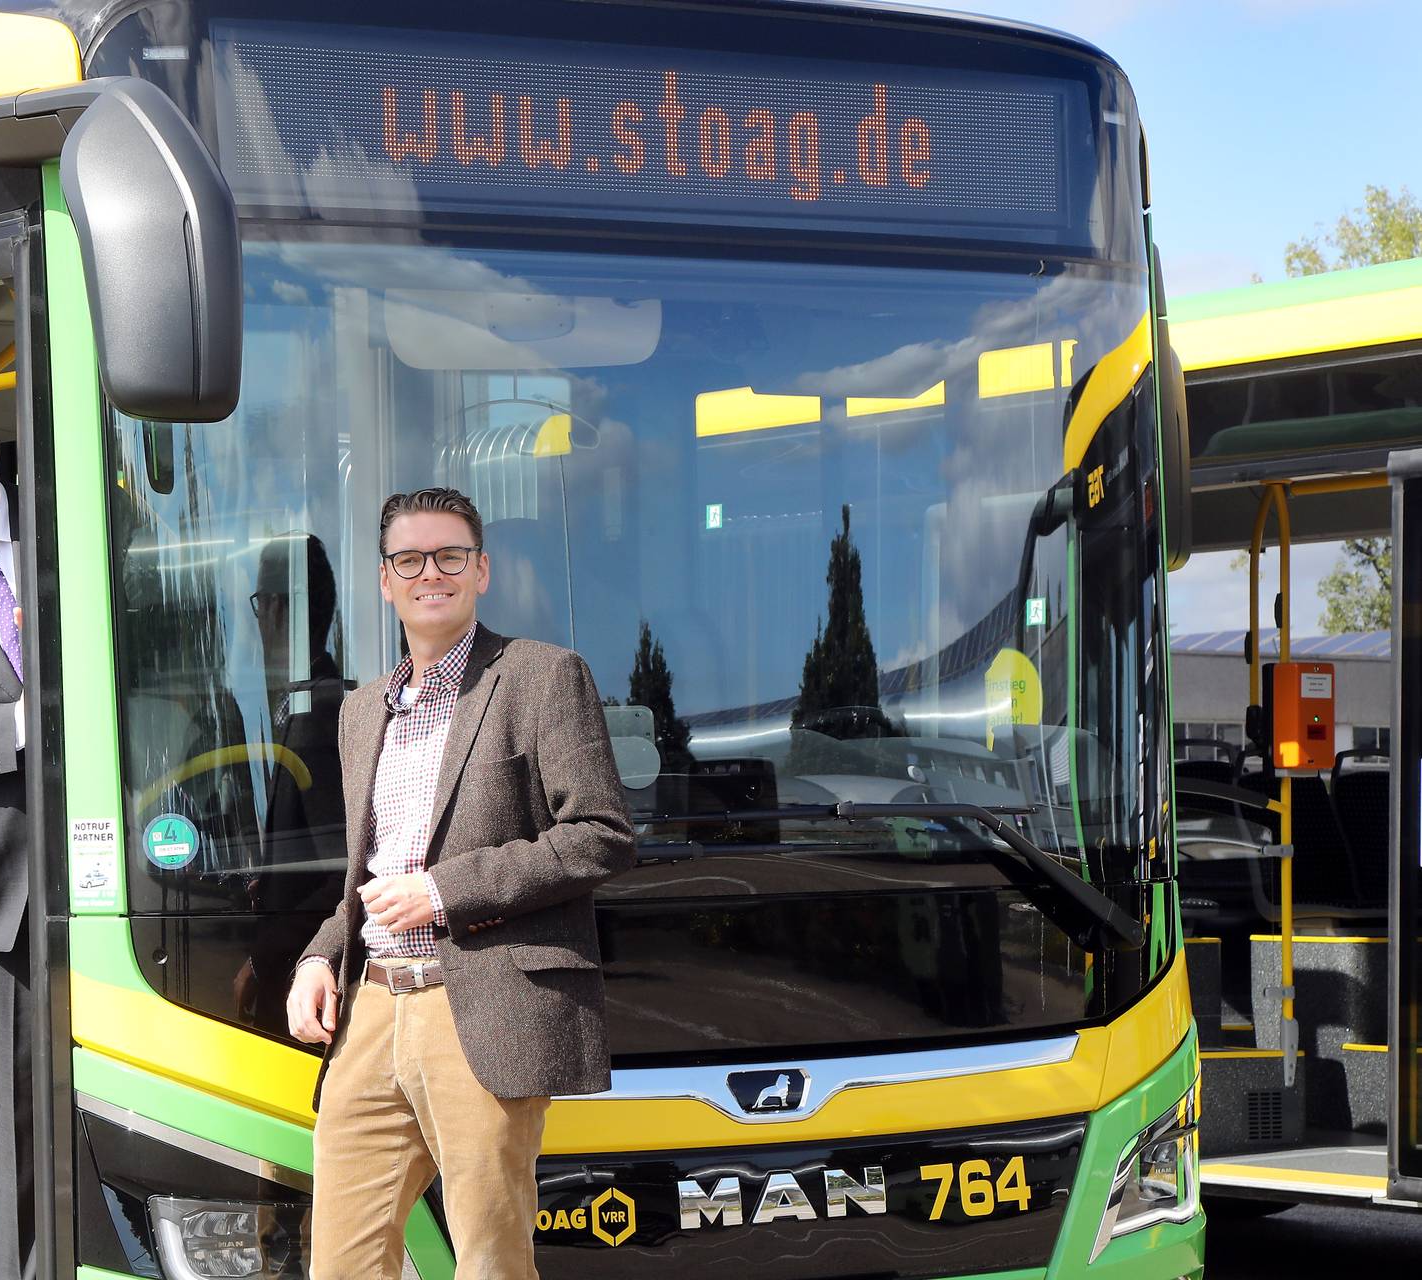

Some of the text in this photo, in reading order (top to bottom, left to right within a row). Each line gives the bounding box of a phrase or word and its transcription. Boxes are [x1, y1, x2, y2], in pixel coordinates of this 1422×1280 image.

[381, 70, 931, 201] www.stoag.de
[73, 832, 114, 842] PARTNER
[74, 822, 111, 831] NOTRUF
[164, 821, 178, 842] 4
[677, 1155, 1032, 1230] MAN 764
[535, 1208, 626, 1231] OAG VRR
